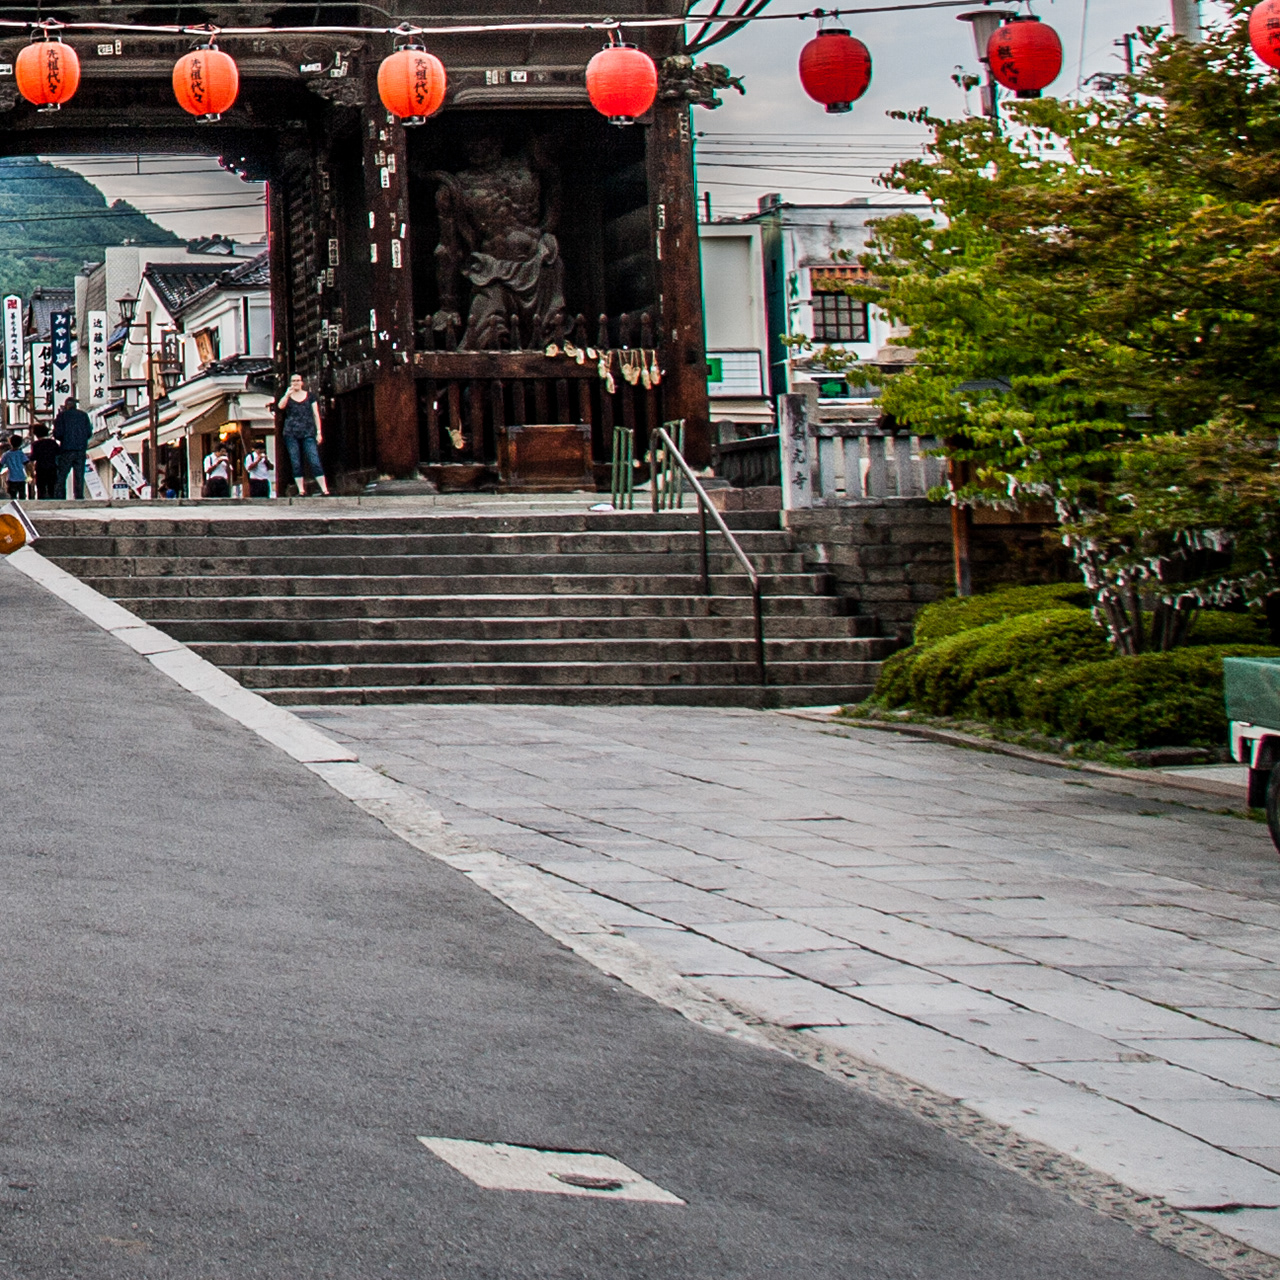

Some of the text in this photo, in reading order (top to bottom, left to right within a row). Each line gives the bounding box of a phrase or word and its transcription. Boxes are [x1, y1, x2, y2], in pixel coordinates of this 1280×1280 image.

[45, 48, 63, 96] 先祖代々
[190, 57, 206, 105] 先祖代々
[414, 57, 429, 105] 先祖代々
[93, 318, 105, 399] 近藤みやげ店
